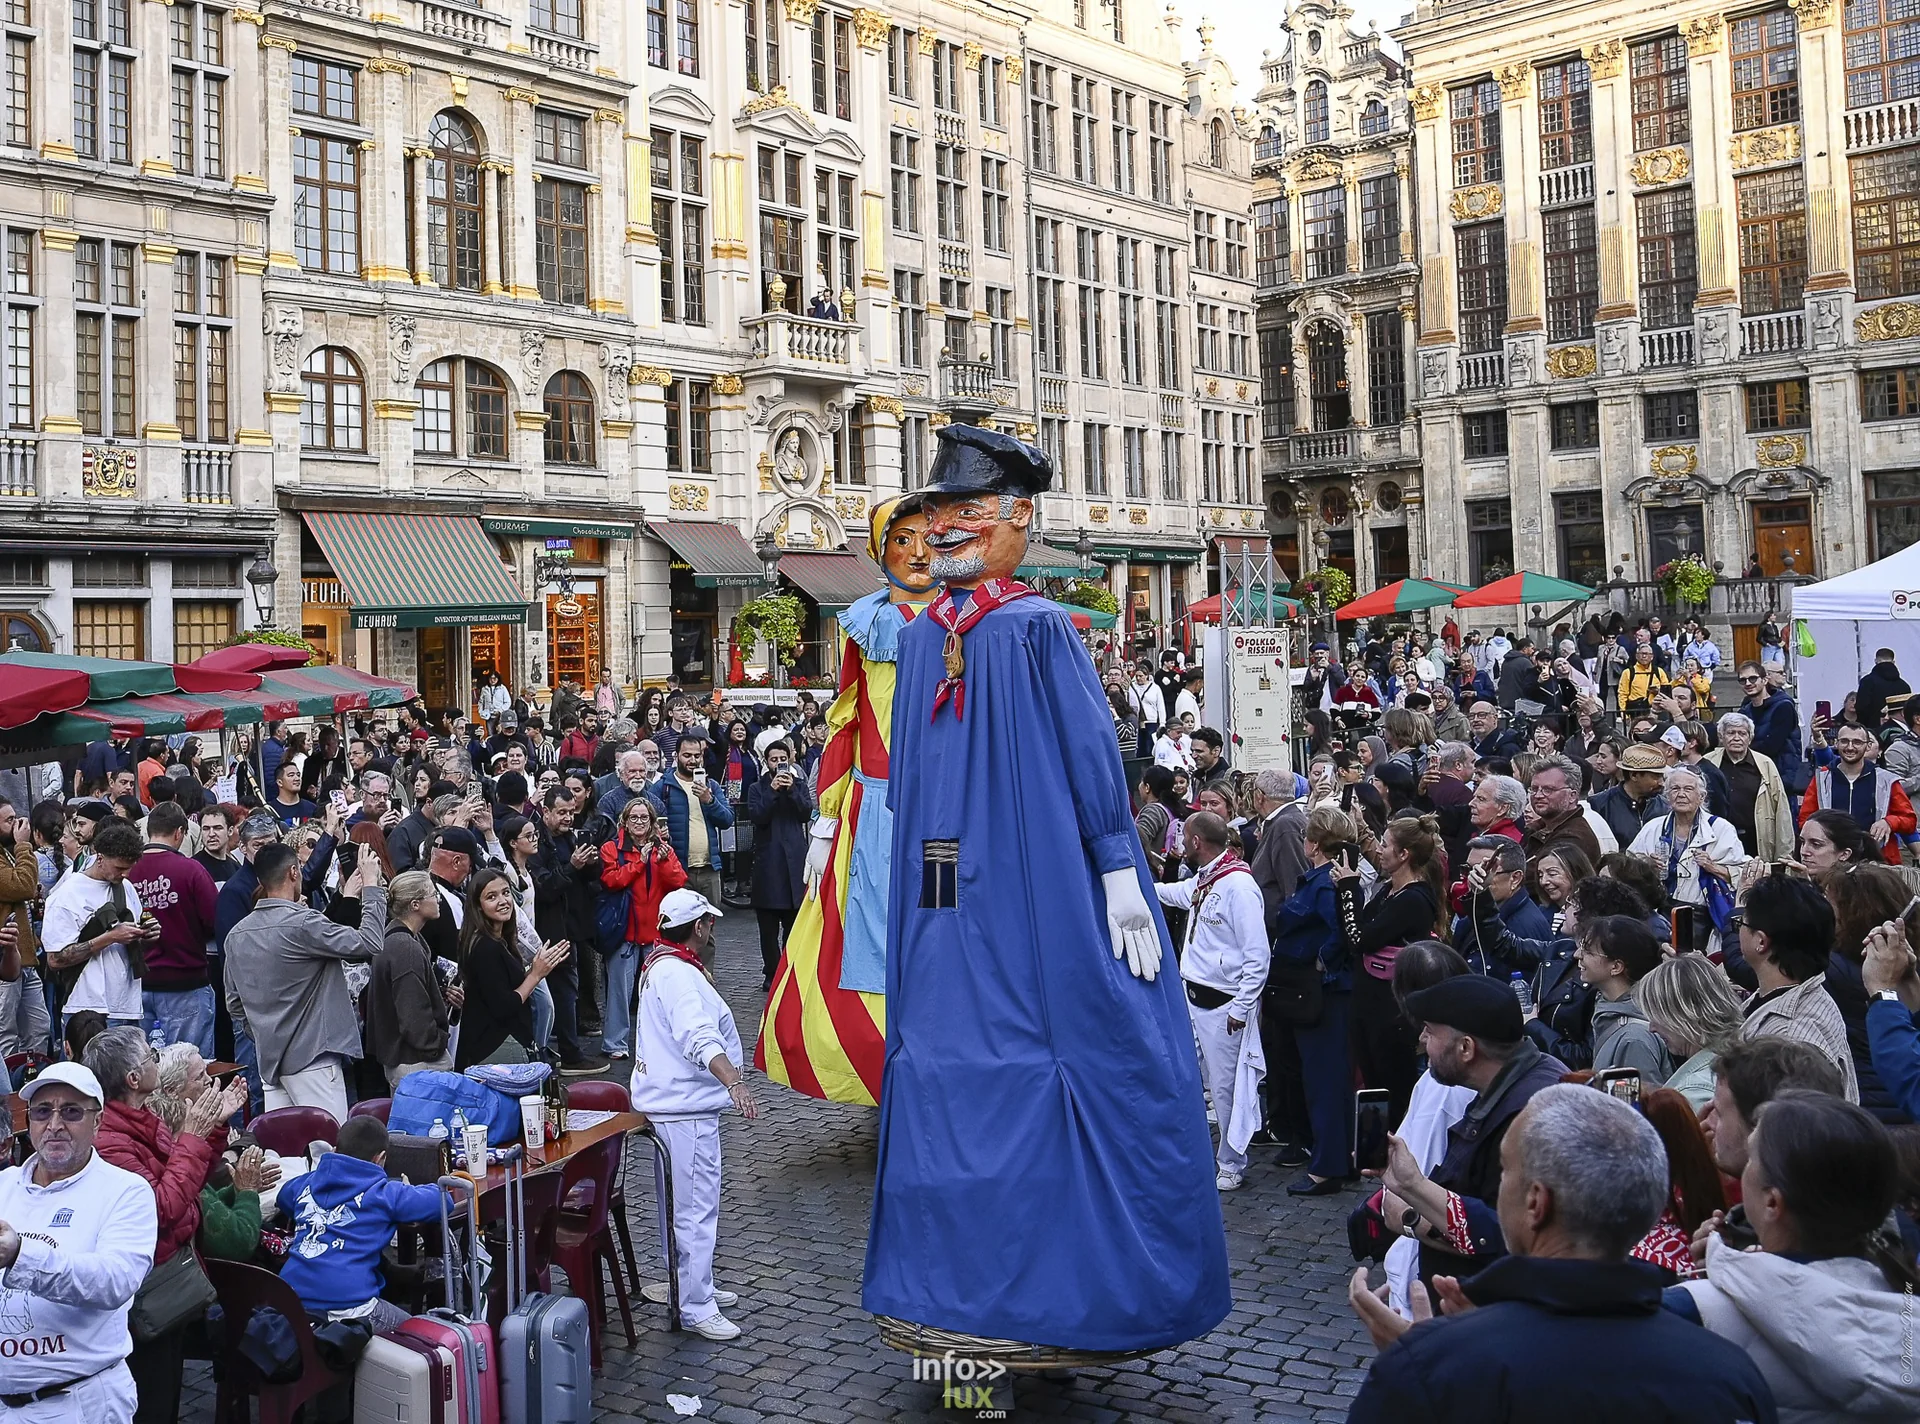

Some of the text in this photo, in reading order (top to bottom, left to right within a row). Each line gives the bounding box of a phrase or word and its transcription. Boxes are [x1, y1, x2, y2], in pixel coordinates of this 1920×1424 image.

[489, 521, 530, 532] GOURMET
[573, 526, 611, 536] Chocolaterie
[300, 582, 349, 603] NEUHA
[357, 614, 398, 628] NEUHAUS
[434, 615, 461, 623] INVENTOR
[479, 614, 500, 622] BELGIAN
[1245, 638, 1276, 647] FOLKLO
[1247, 645, 1282, 655] RISSIMO
[142, 890, 179, 909] uge
